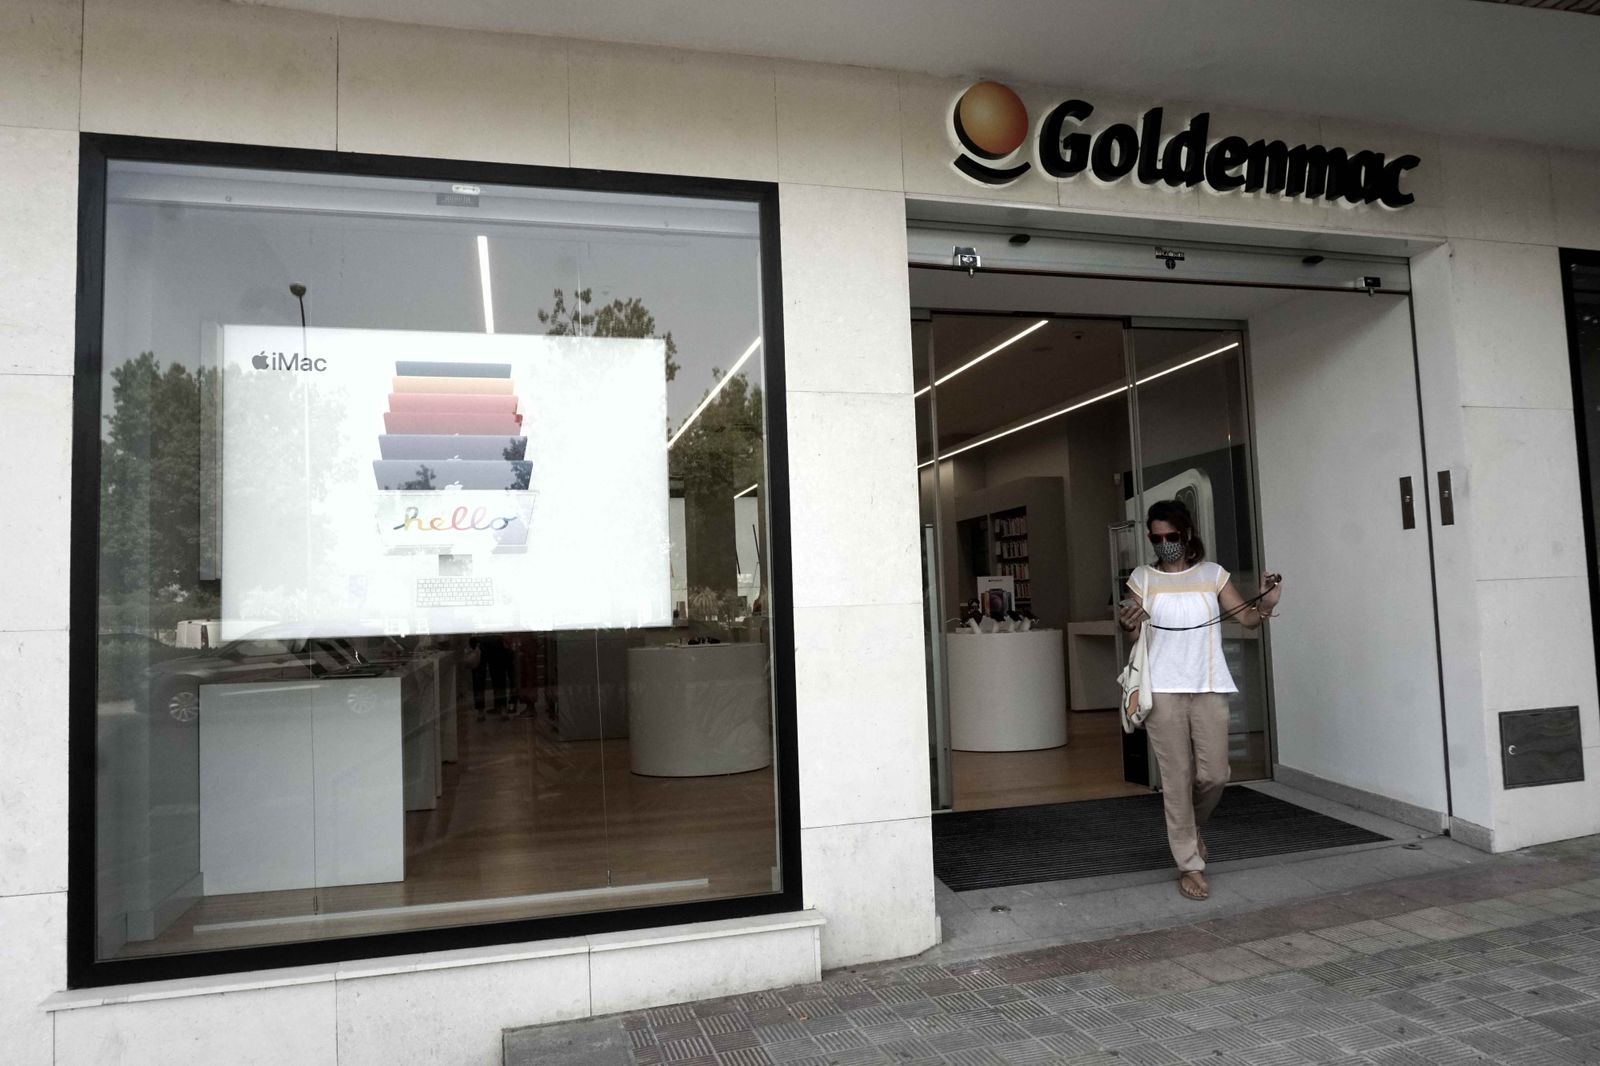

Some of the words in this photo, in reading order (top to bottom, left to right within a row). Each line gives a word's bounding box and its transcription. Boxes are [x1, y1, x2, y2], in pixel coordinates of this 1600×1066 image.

[1039, 99, 1421, 208] Goldenmac
[272, 352, 327, 371] iMac
[393, 506, 517, 531] hello
